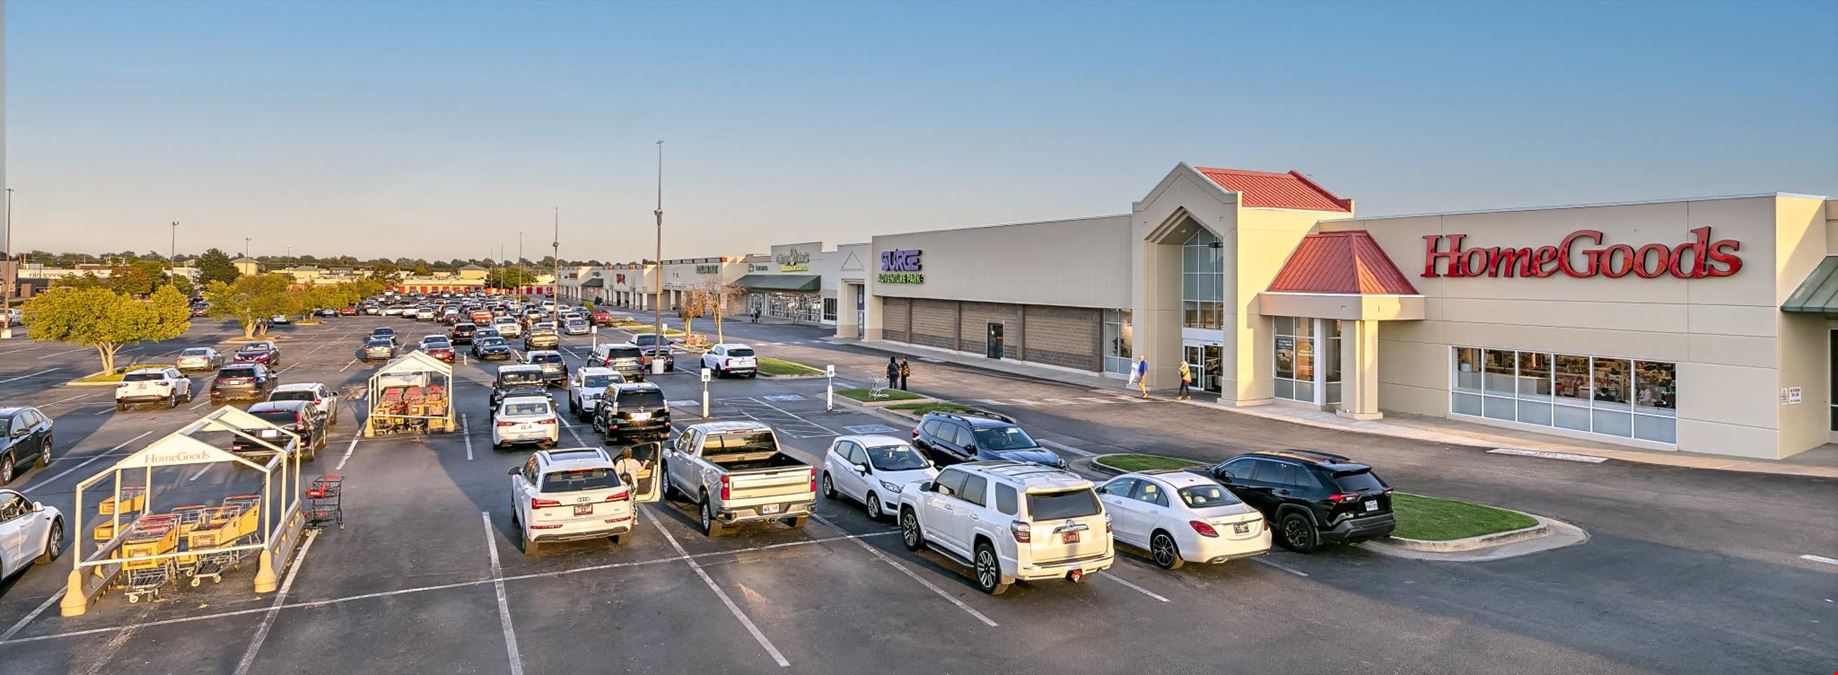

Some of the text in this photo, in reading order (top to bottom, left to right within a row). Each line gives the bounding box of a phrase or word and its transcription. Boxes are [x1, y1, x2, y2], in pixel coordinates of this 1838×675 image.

[880, 248, 922, 271] SURGE
[1420, 226, 1743, 279] HomeGoods
[878, 273, 923, 284] ADVENTURE PARK
[144, 450, 210, 464] HomeGoods
